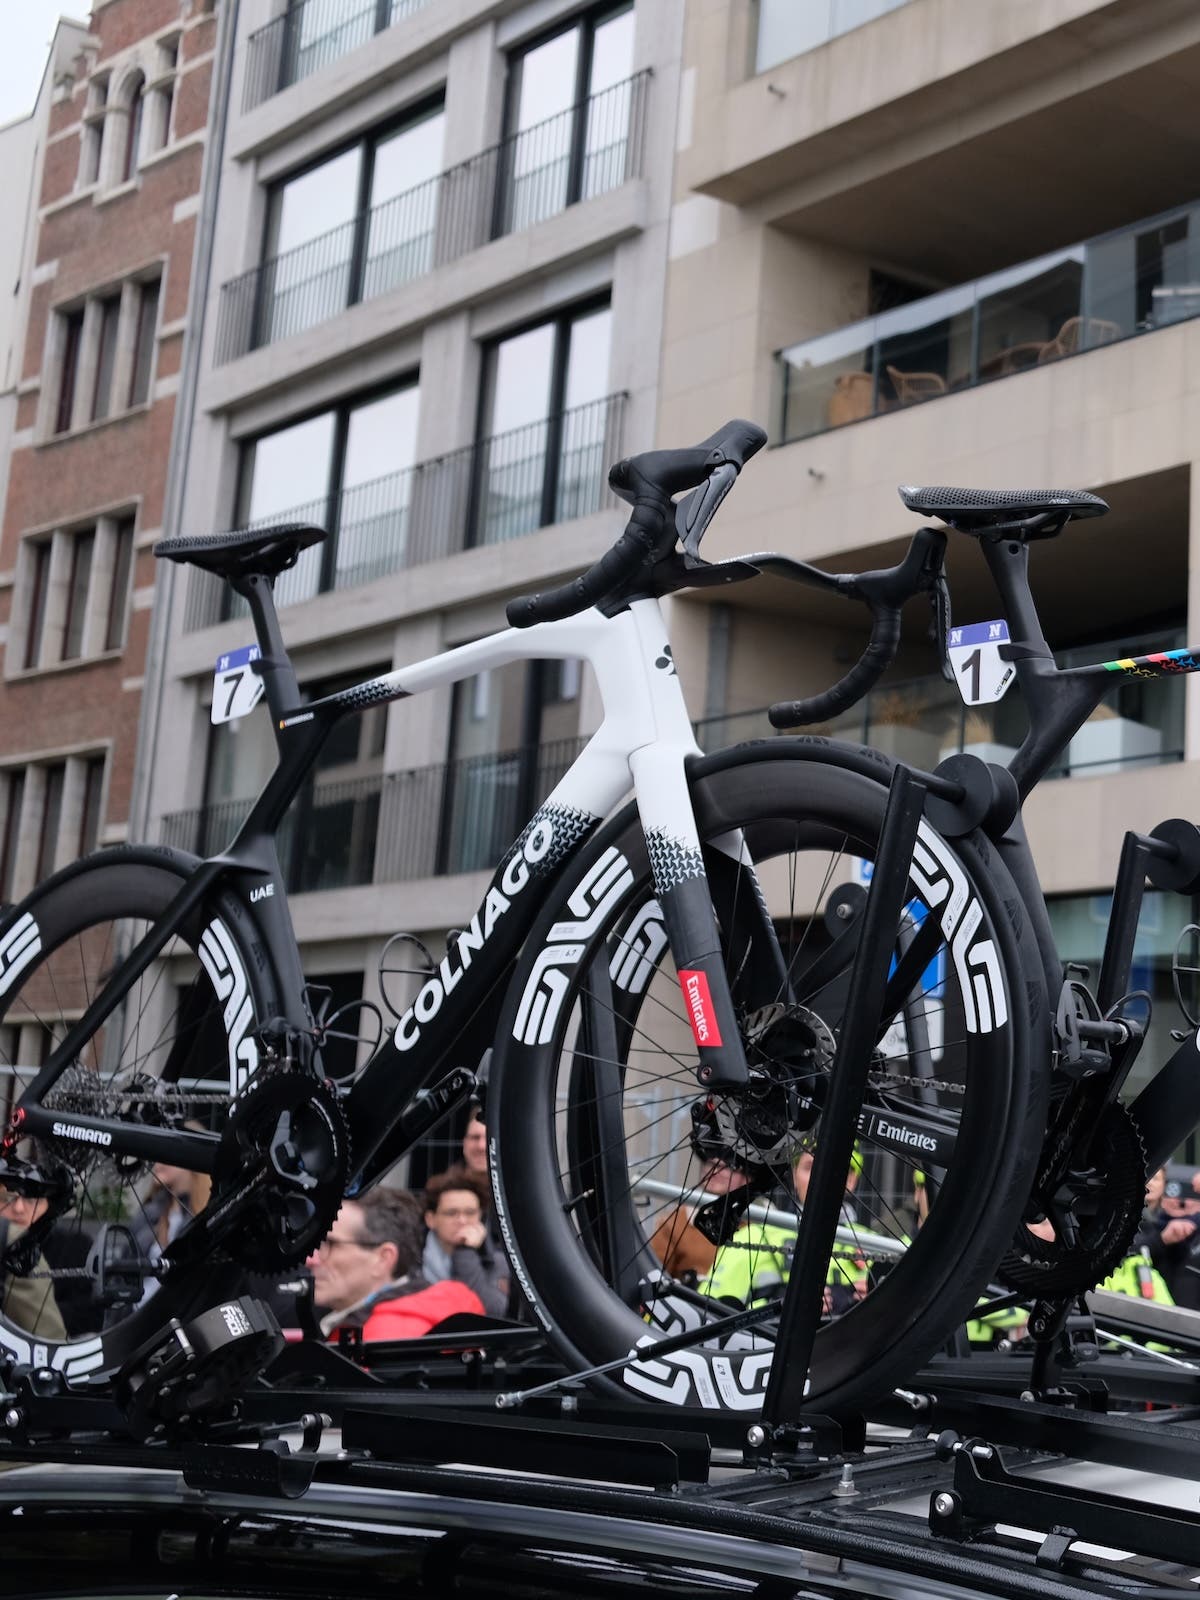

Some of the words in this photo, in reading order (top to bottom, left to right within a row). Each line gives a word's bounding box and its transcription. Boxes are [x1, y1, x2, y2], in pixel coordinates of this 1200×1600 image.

[989, 623, 1002, 638] N
[223, 671, 245, 718] 7
[961, 648, 982, 702] 1
[249, 883, 275, 903] UAE
[394, 818, 554, 1052] COLNAGO
[686, 974, 710, 1042] Emirates
[52, 1121, 112, 1147] SHIMANO
[876, 1119, 938, 1152] Emirates
